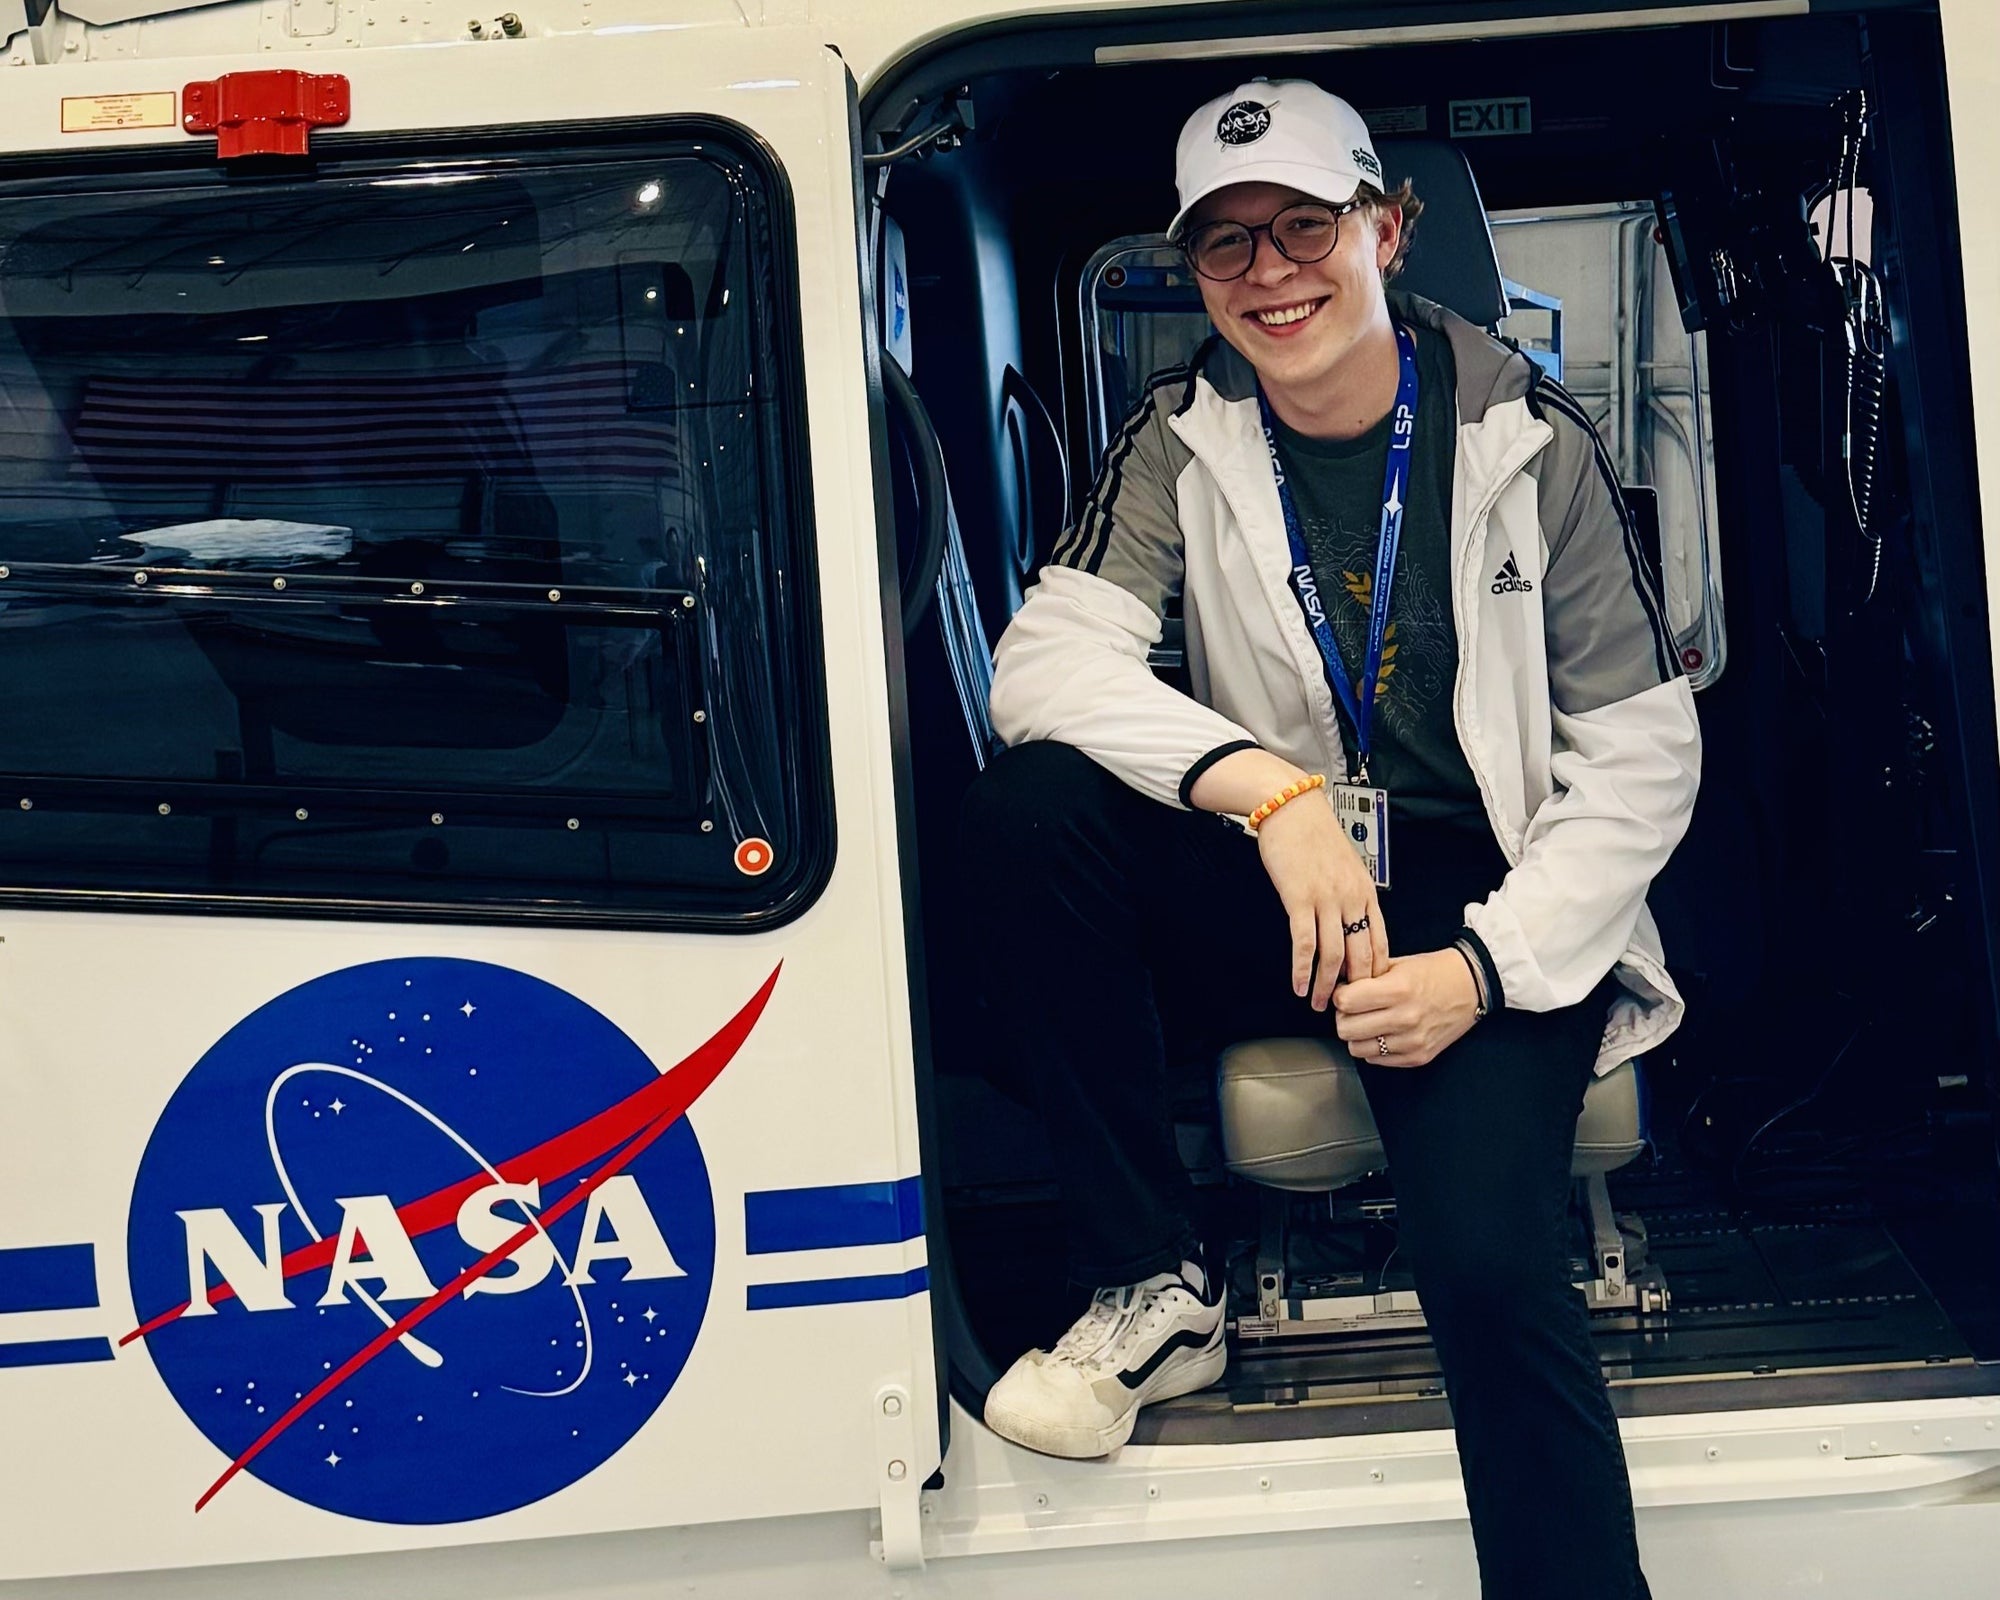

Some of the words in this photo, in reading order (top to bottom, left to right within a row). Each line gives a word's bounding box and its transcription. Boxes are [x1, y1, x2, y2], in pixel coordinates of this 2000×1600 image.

[1452, 102, 1527, 132] EXIT
[1393, 404, 1414, 449] LSP
[1294, 564, 1326, 628] NASA
[1491, 577, 1533, 595] adias
[174, 1174, 688, 1318] NASA
